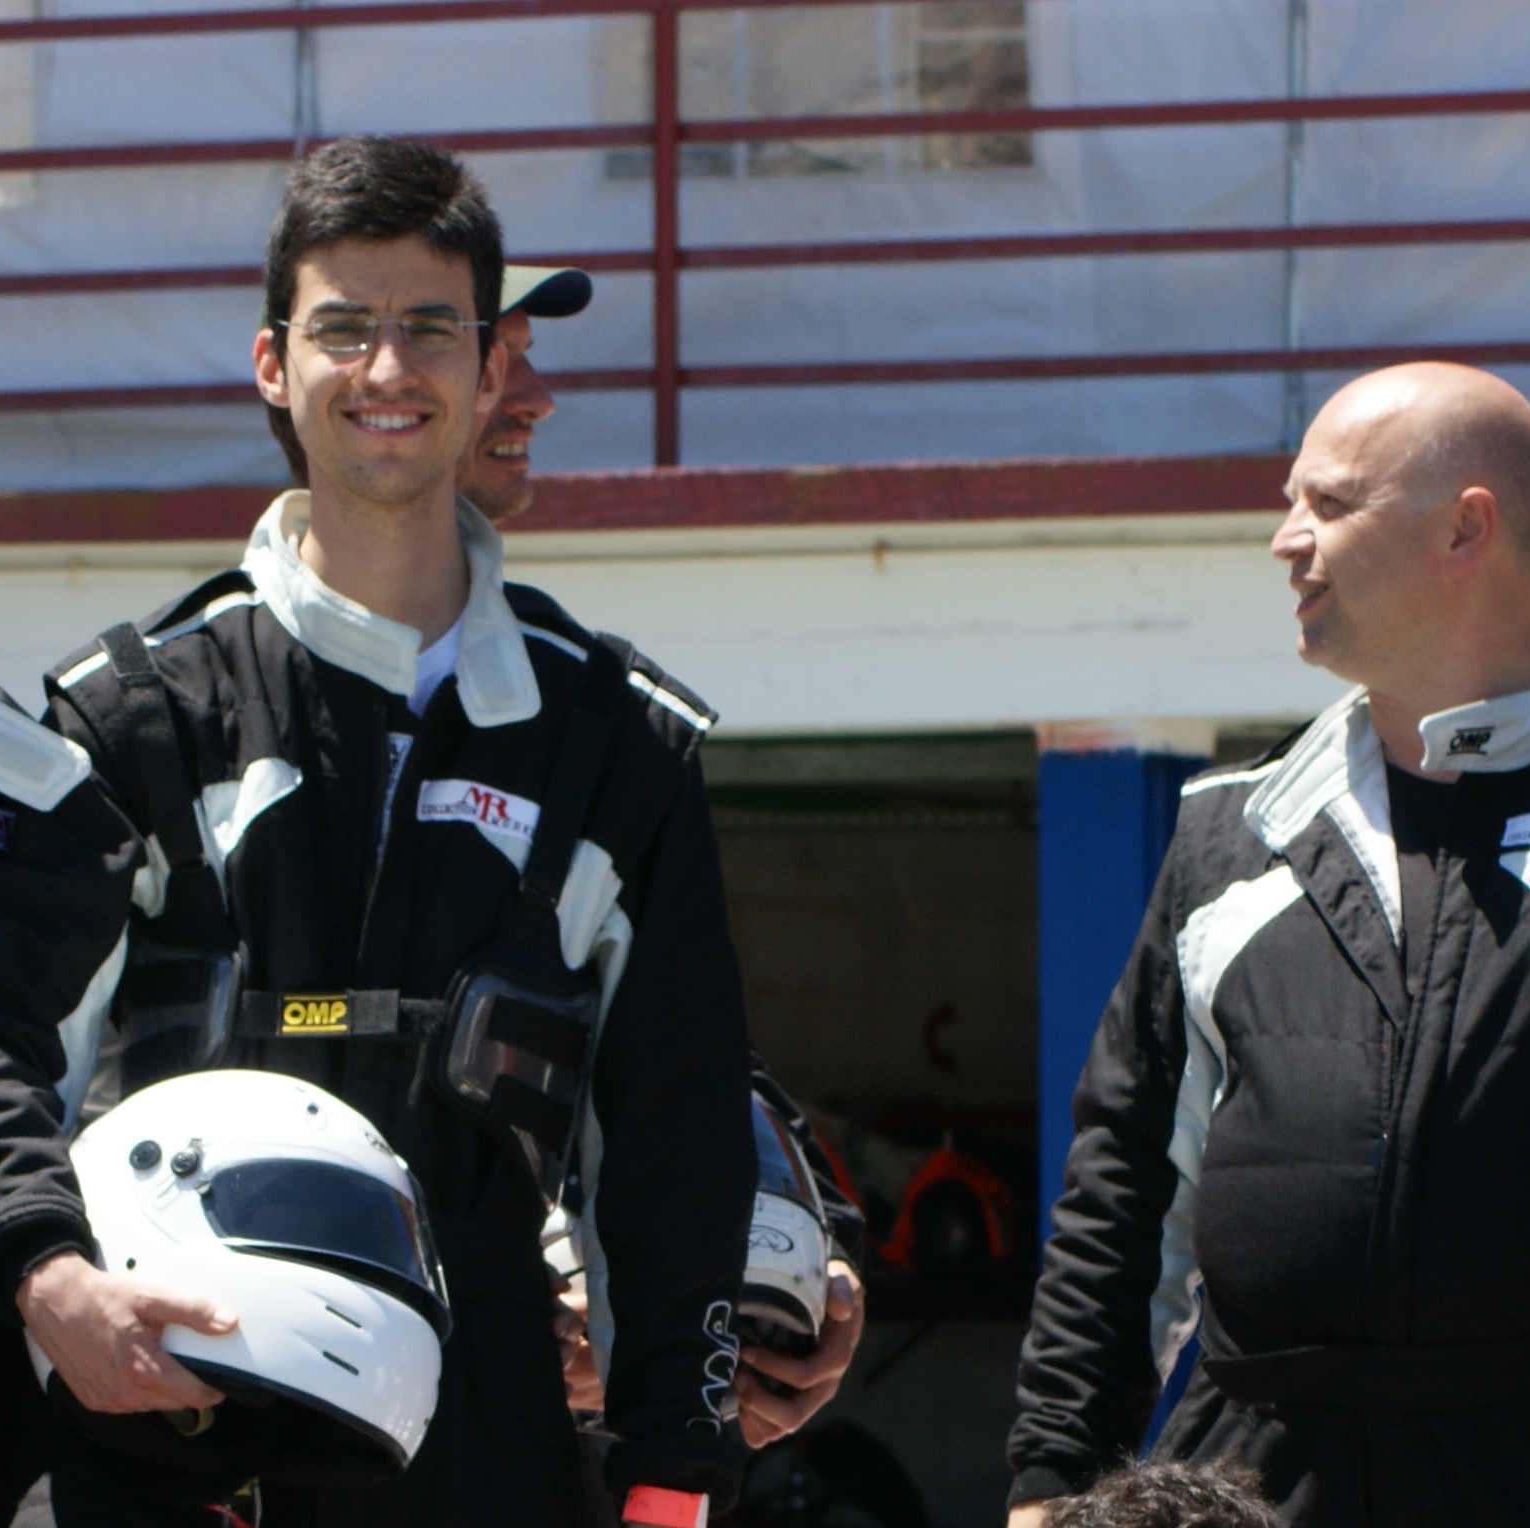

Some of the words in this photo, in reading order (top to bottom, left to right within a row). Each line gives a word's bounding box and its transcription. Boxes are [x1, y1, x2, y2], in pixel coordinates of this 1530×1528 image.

[1448, 731, 1492, 750] OMP
[458, 786, 511, 822] MR
[283, 1000, 347, 1025] OMP
